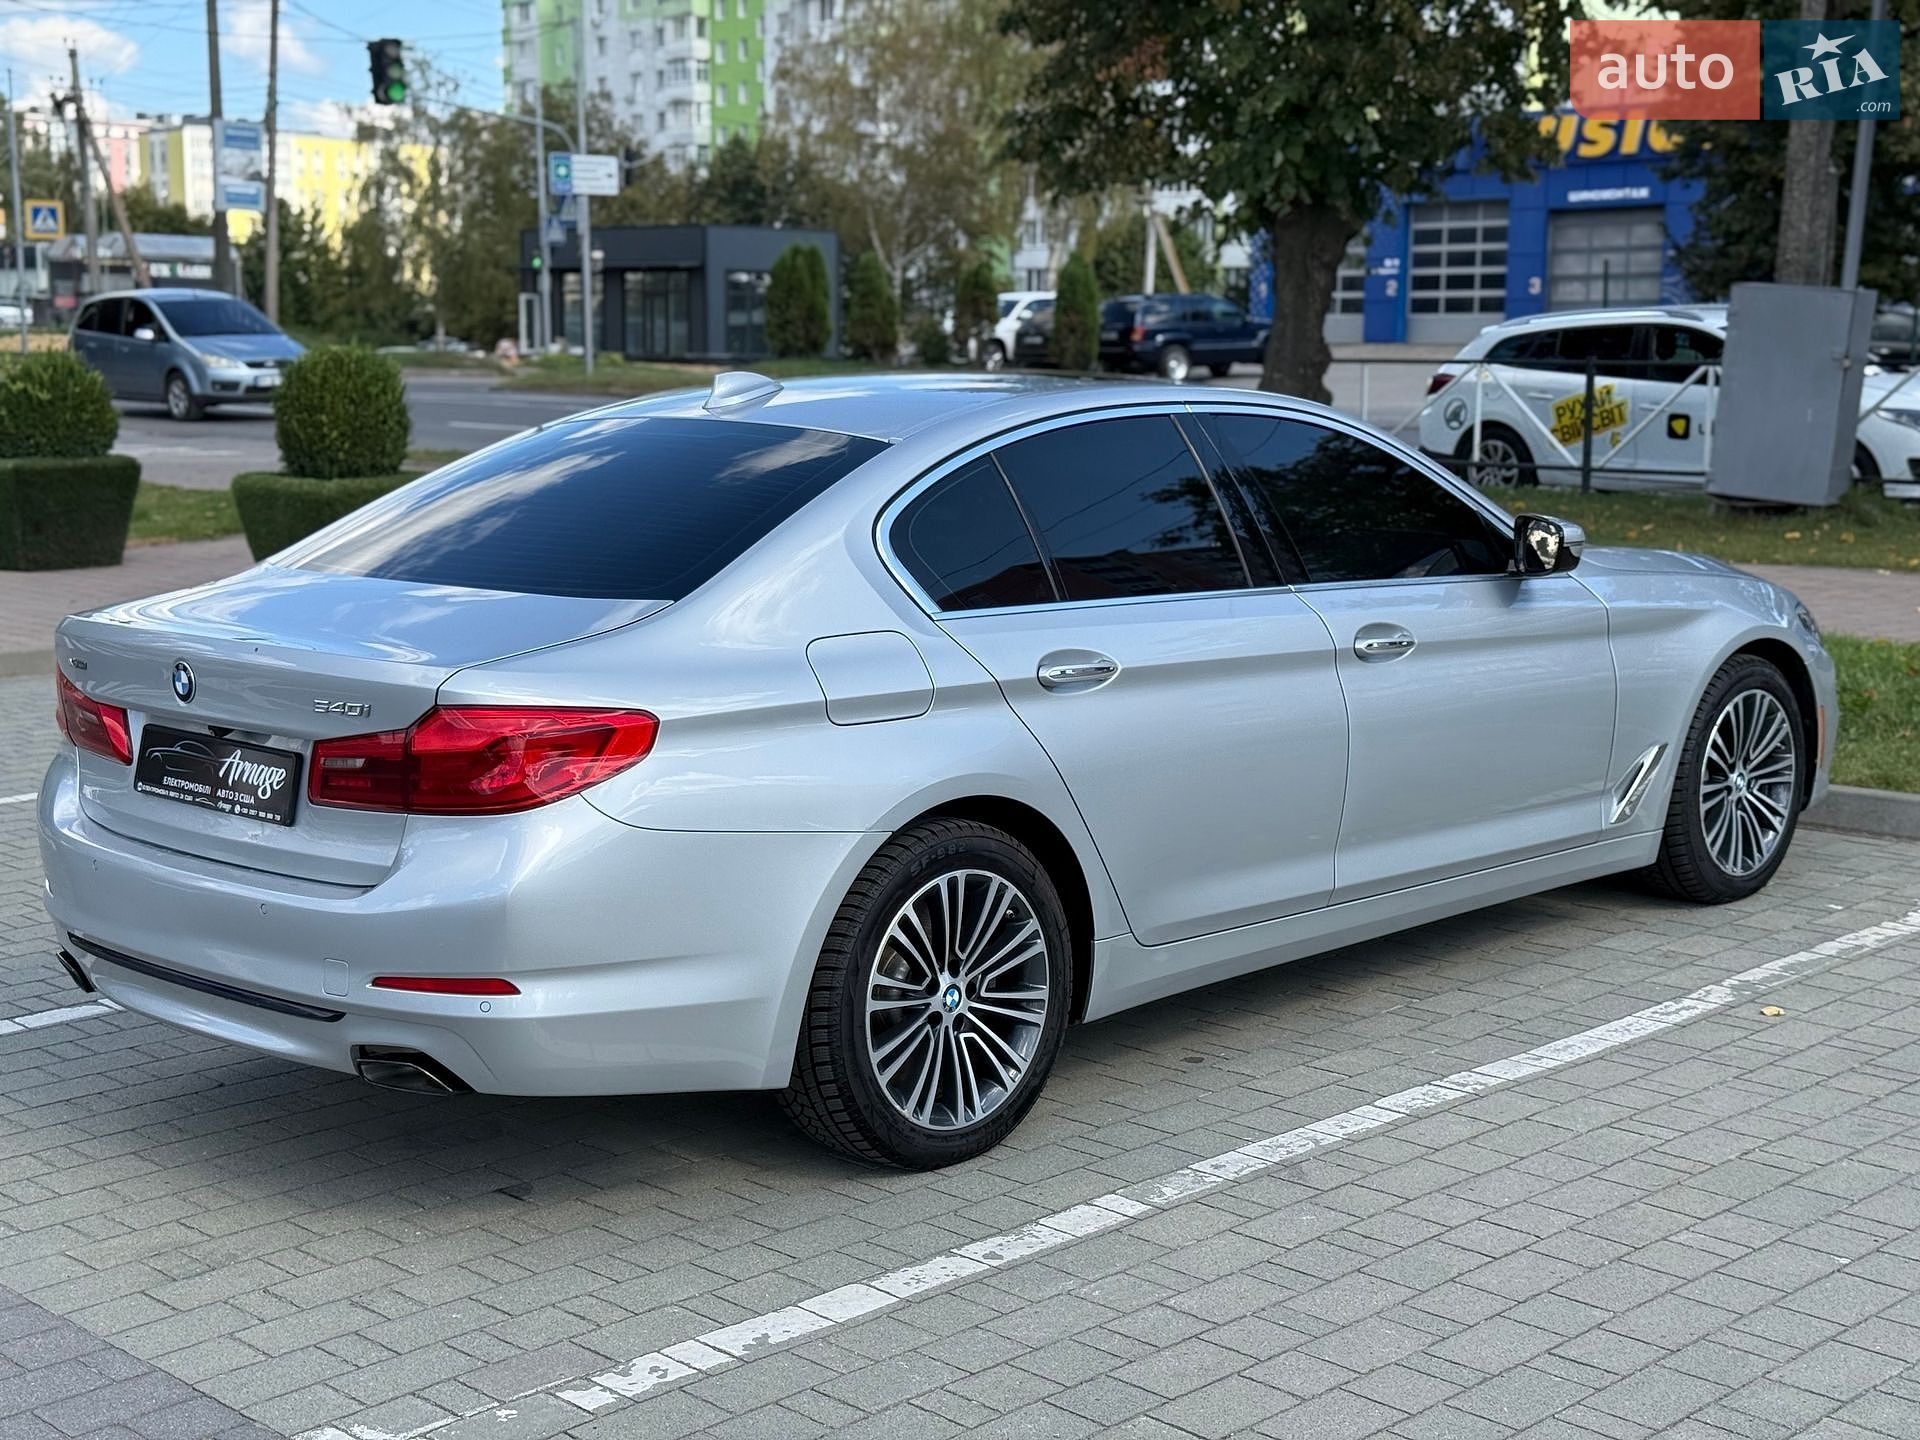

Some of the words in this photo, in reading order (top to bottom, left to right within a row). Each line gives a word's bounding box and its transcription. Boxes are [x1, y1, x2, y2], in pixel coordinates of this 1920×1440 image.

[1528, 276, 1543, 295] 3
[313, 699, 372, 718] 540i
[218, 749, 286, 799] Arnage
[216, 788, 234, 801] АВТО
[239, 794, 255, 804] США
